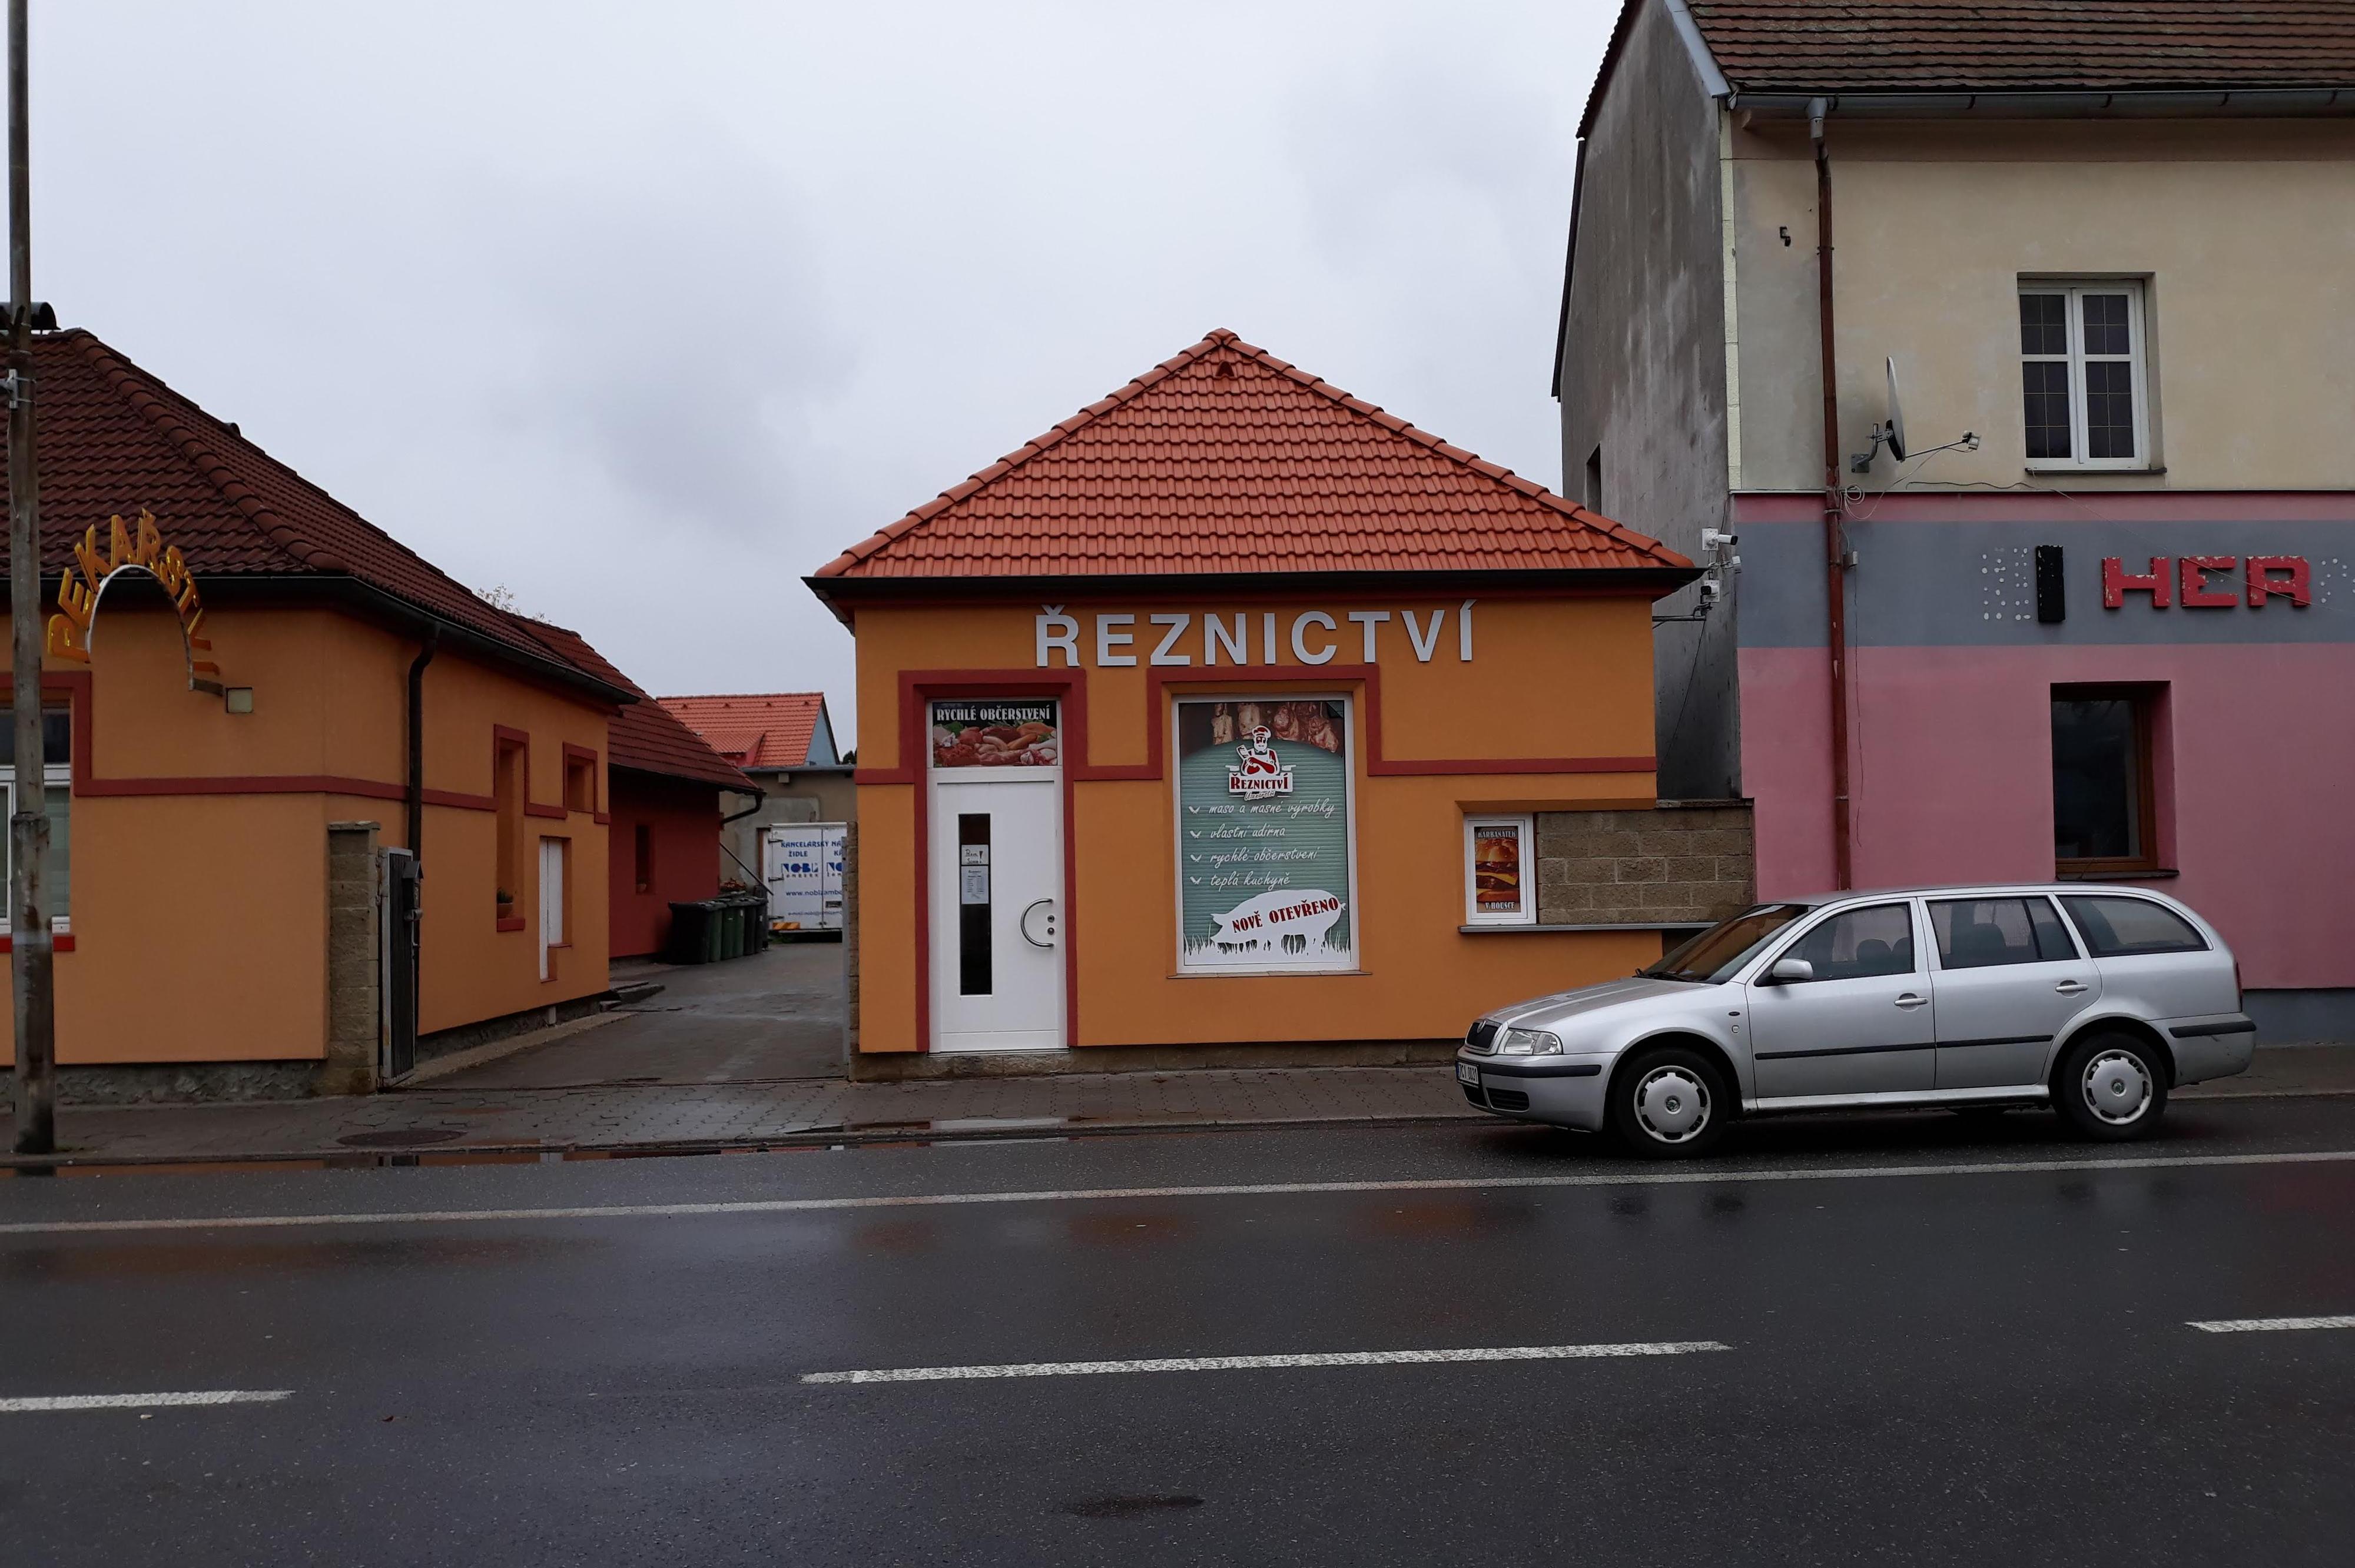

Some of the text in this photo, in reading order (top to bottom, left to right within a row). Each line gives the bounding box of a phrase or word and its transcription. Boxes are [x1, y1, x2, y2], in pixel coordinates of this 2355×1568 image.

[2101, 555, 2311, 609] HER
[1036, 599, 1477, 667] ŘEZNICTVÍ
[937, 705, 1050, 721] RYCHLÉ OBČERSTVENÍ
[1230, 773, 1288, 789] ŘEZNICTVÍ
[1208, 805, 1235, 814] maso
[1251, 801, 1283, 814] masné
[1287, 798, 1335, 819] výrobky
[1210, 823, 1285, 839] vlastní udírna
[1210, 846, 1320, 869] rychlé občerstvení
[1210, 871, 1291, 892] teplá kuchyně
[1232, 897, 1339, 933] NOVĚ OTEVŘENO
